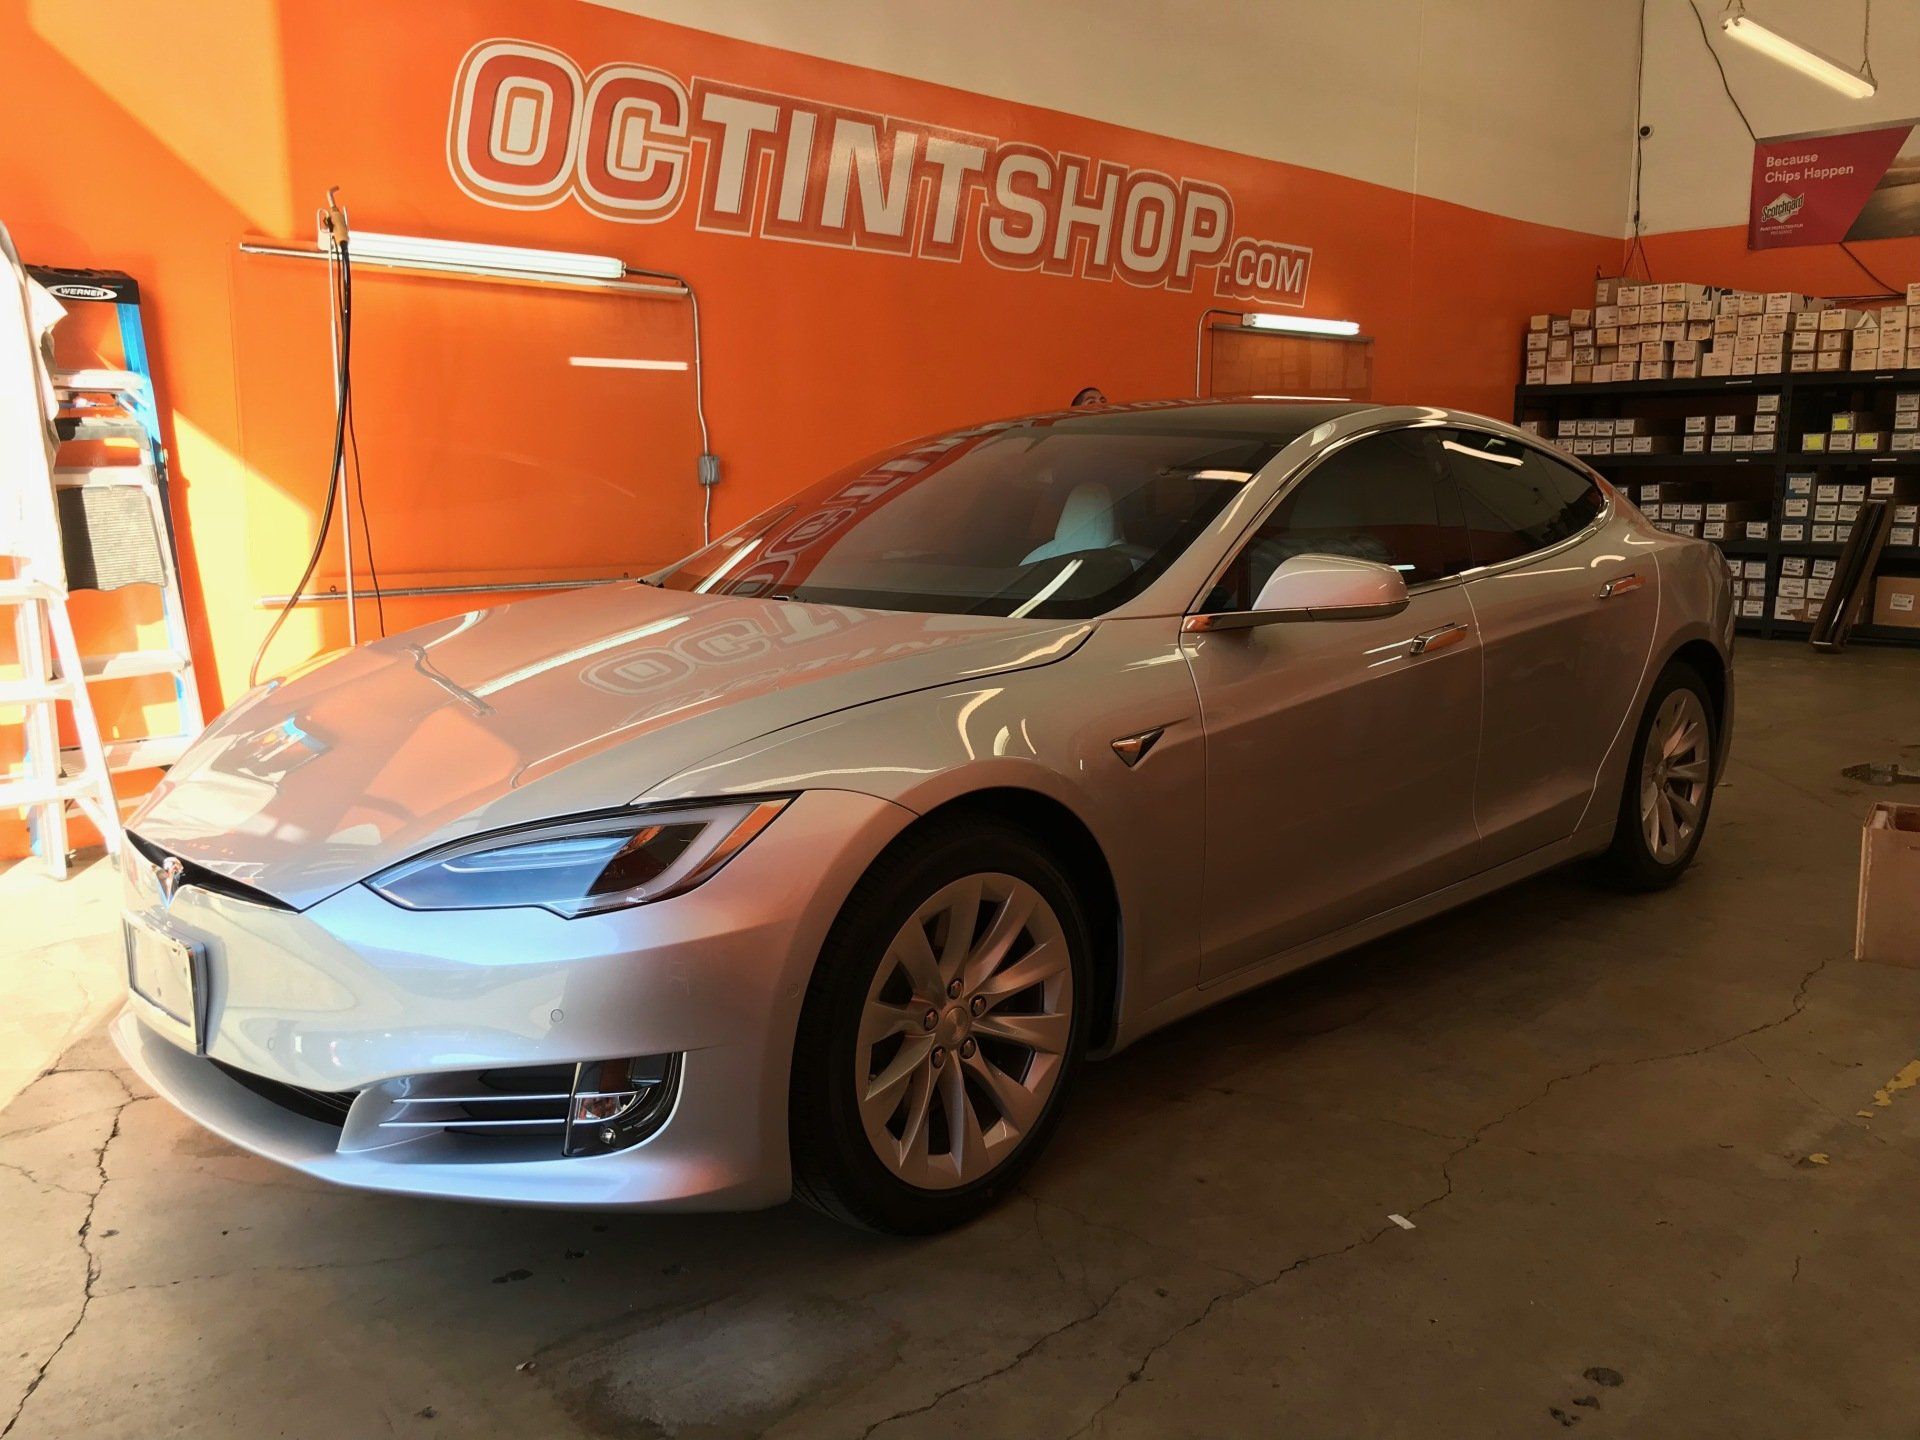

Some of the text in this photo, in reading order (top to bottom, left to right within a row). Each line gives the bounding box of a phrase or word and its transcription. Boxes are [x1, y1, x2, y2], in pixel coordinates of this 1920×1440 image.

[1766, 153, 1819, 168] Because
[1764, 165, 1854, 184] Chips Happen
[60, 287, 104, 297] WERNER
